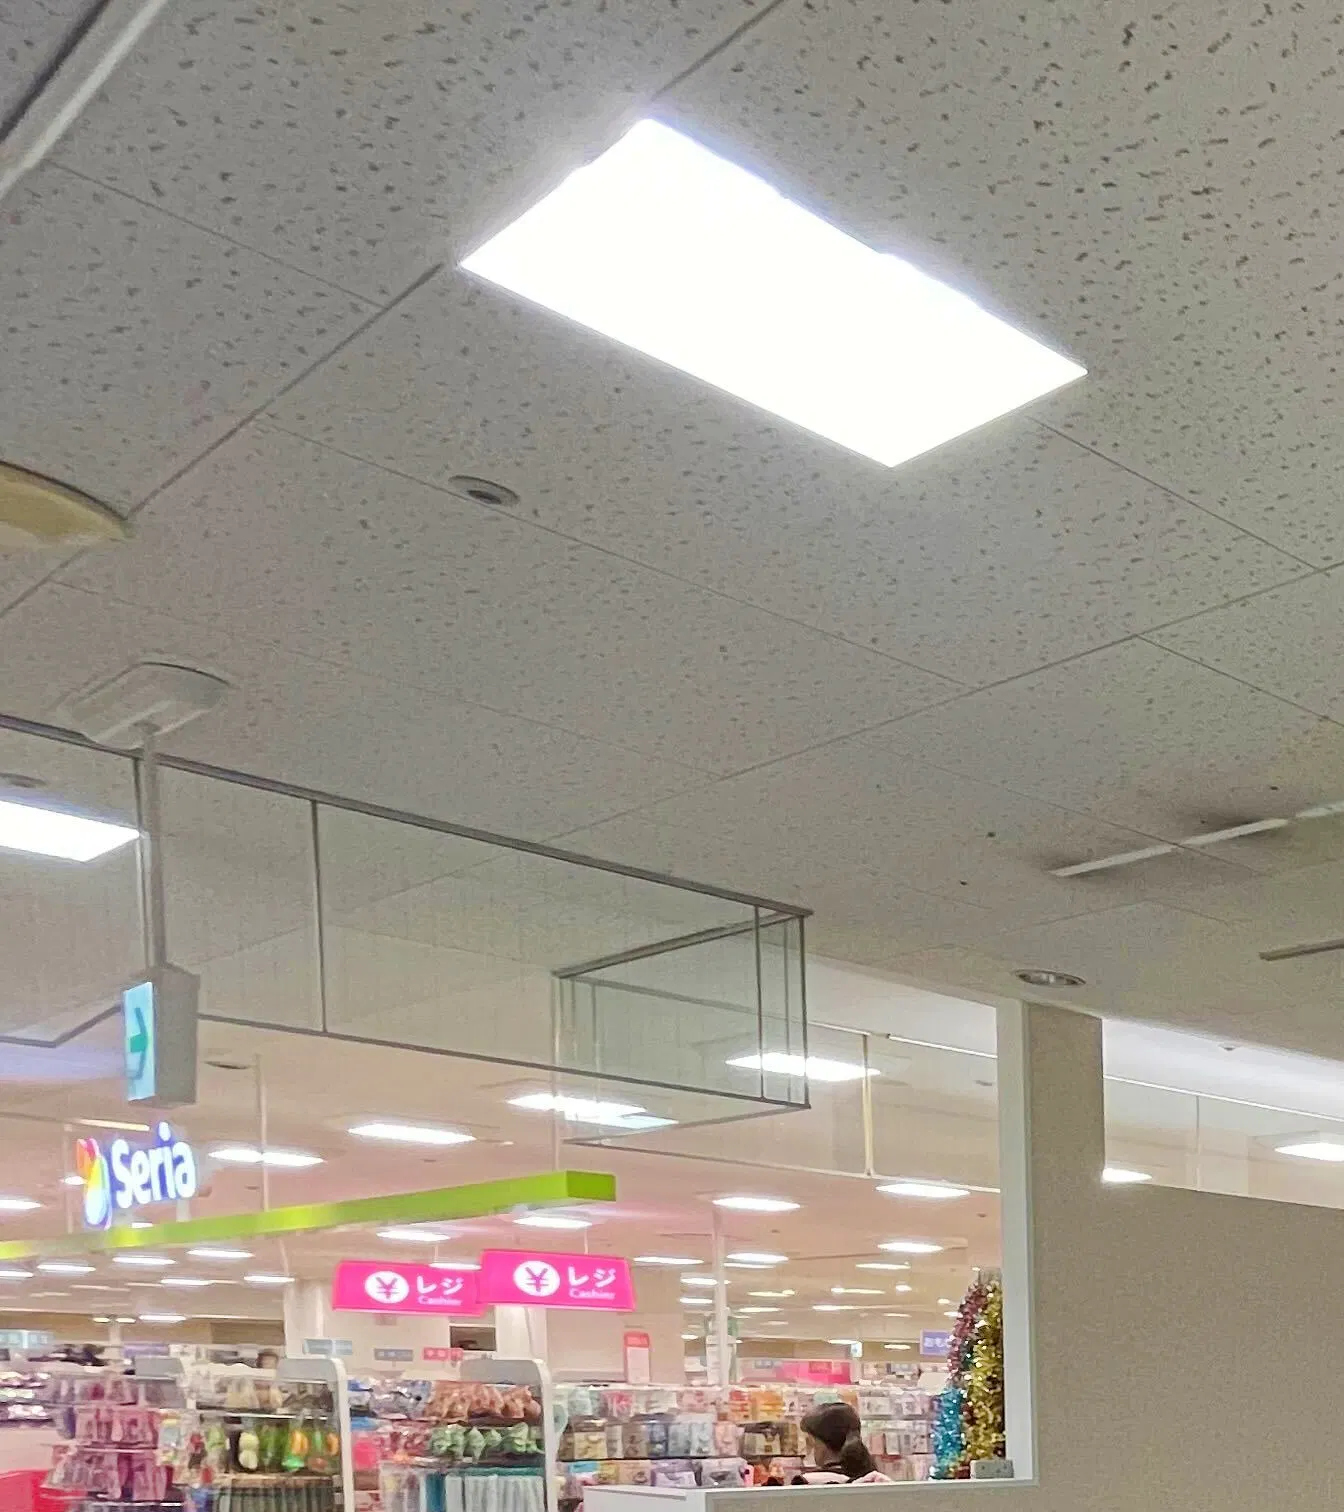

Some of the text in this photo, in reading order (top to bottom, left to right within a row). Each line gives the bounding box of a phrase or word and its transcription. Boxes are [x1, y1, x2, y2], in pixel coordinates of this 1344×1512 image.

[112, 1122, 197, 1208] Seria
[416, 1275, 465, 1296] レジ
[567, 1266, 617, 1289] レジ
